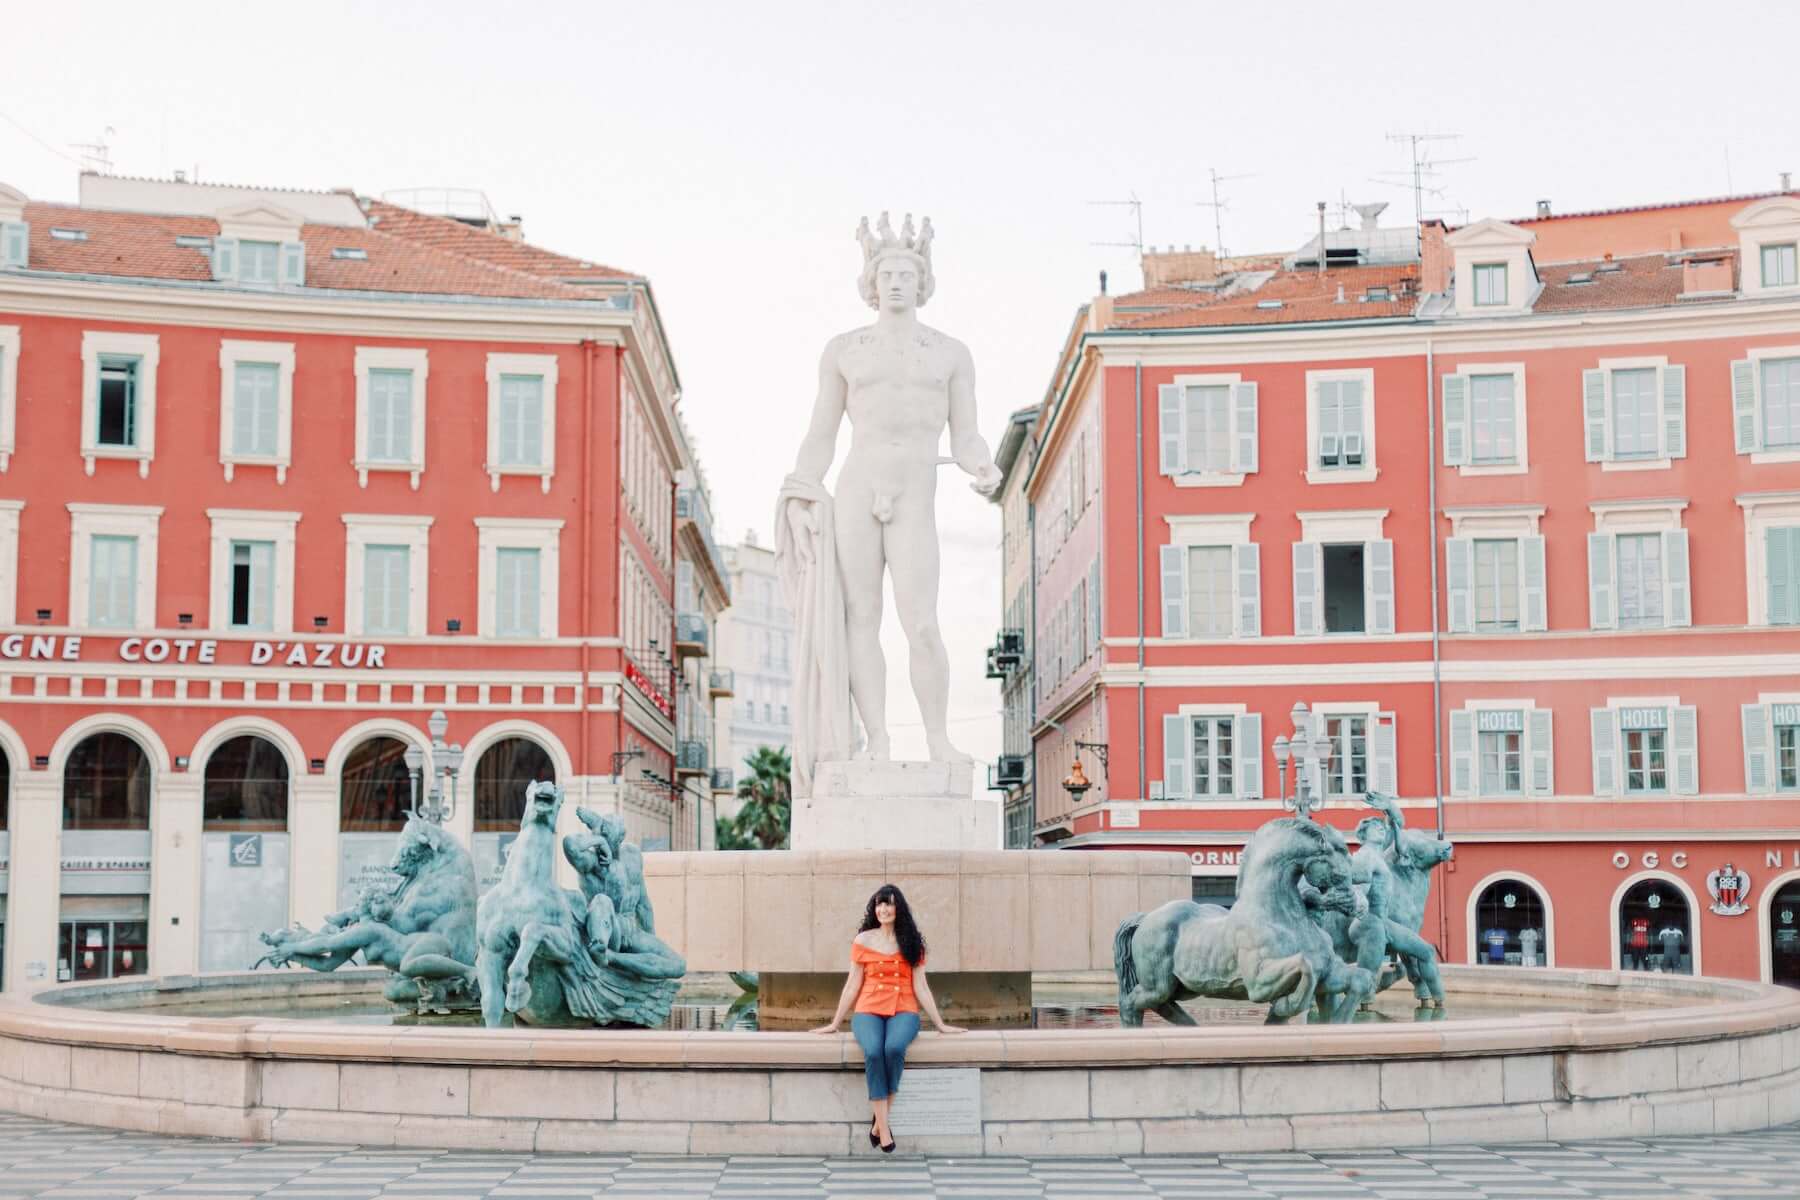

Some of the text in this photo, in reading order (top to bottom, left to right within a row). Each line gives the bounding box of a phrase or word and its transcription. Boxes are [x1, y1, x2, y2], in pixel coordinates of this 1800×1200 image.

[1, 634, 386, 668] GNE COTE D'AZUR
[1480, 711, 1522, 729] HOTEL
[1622, 708, 1665, 727] HOTEL
[1612, 851, 1688, 870] OGC
